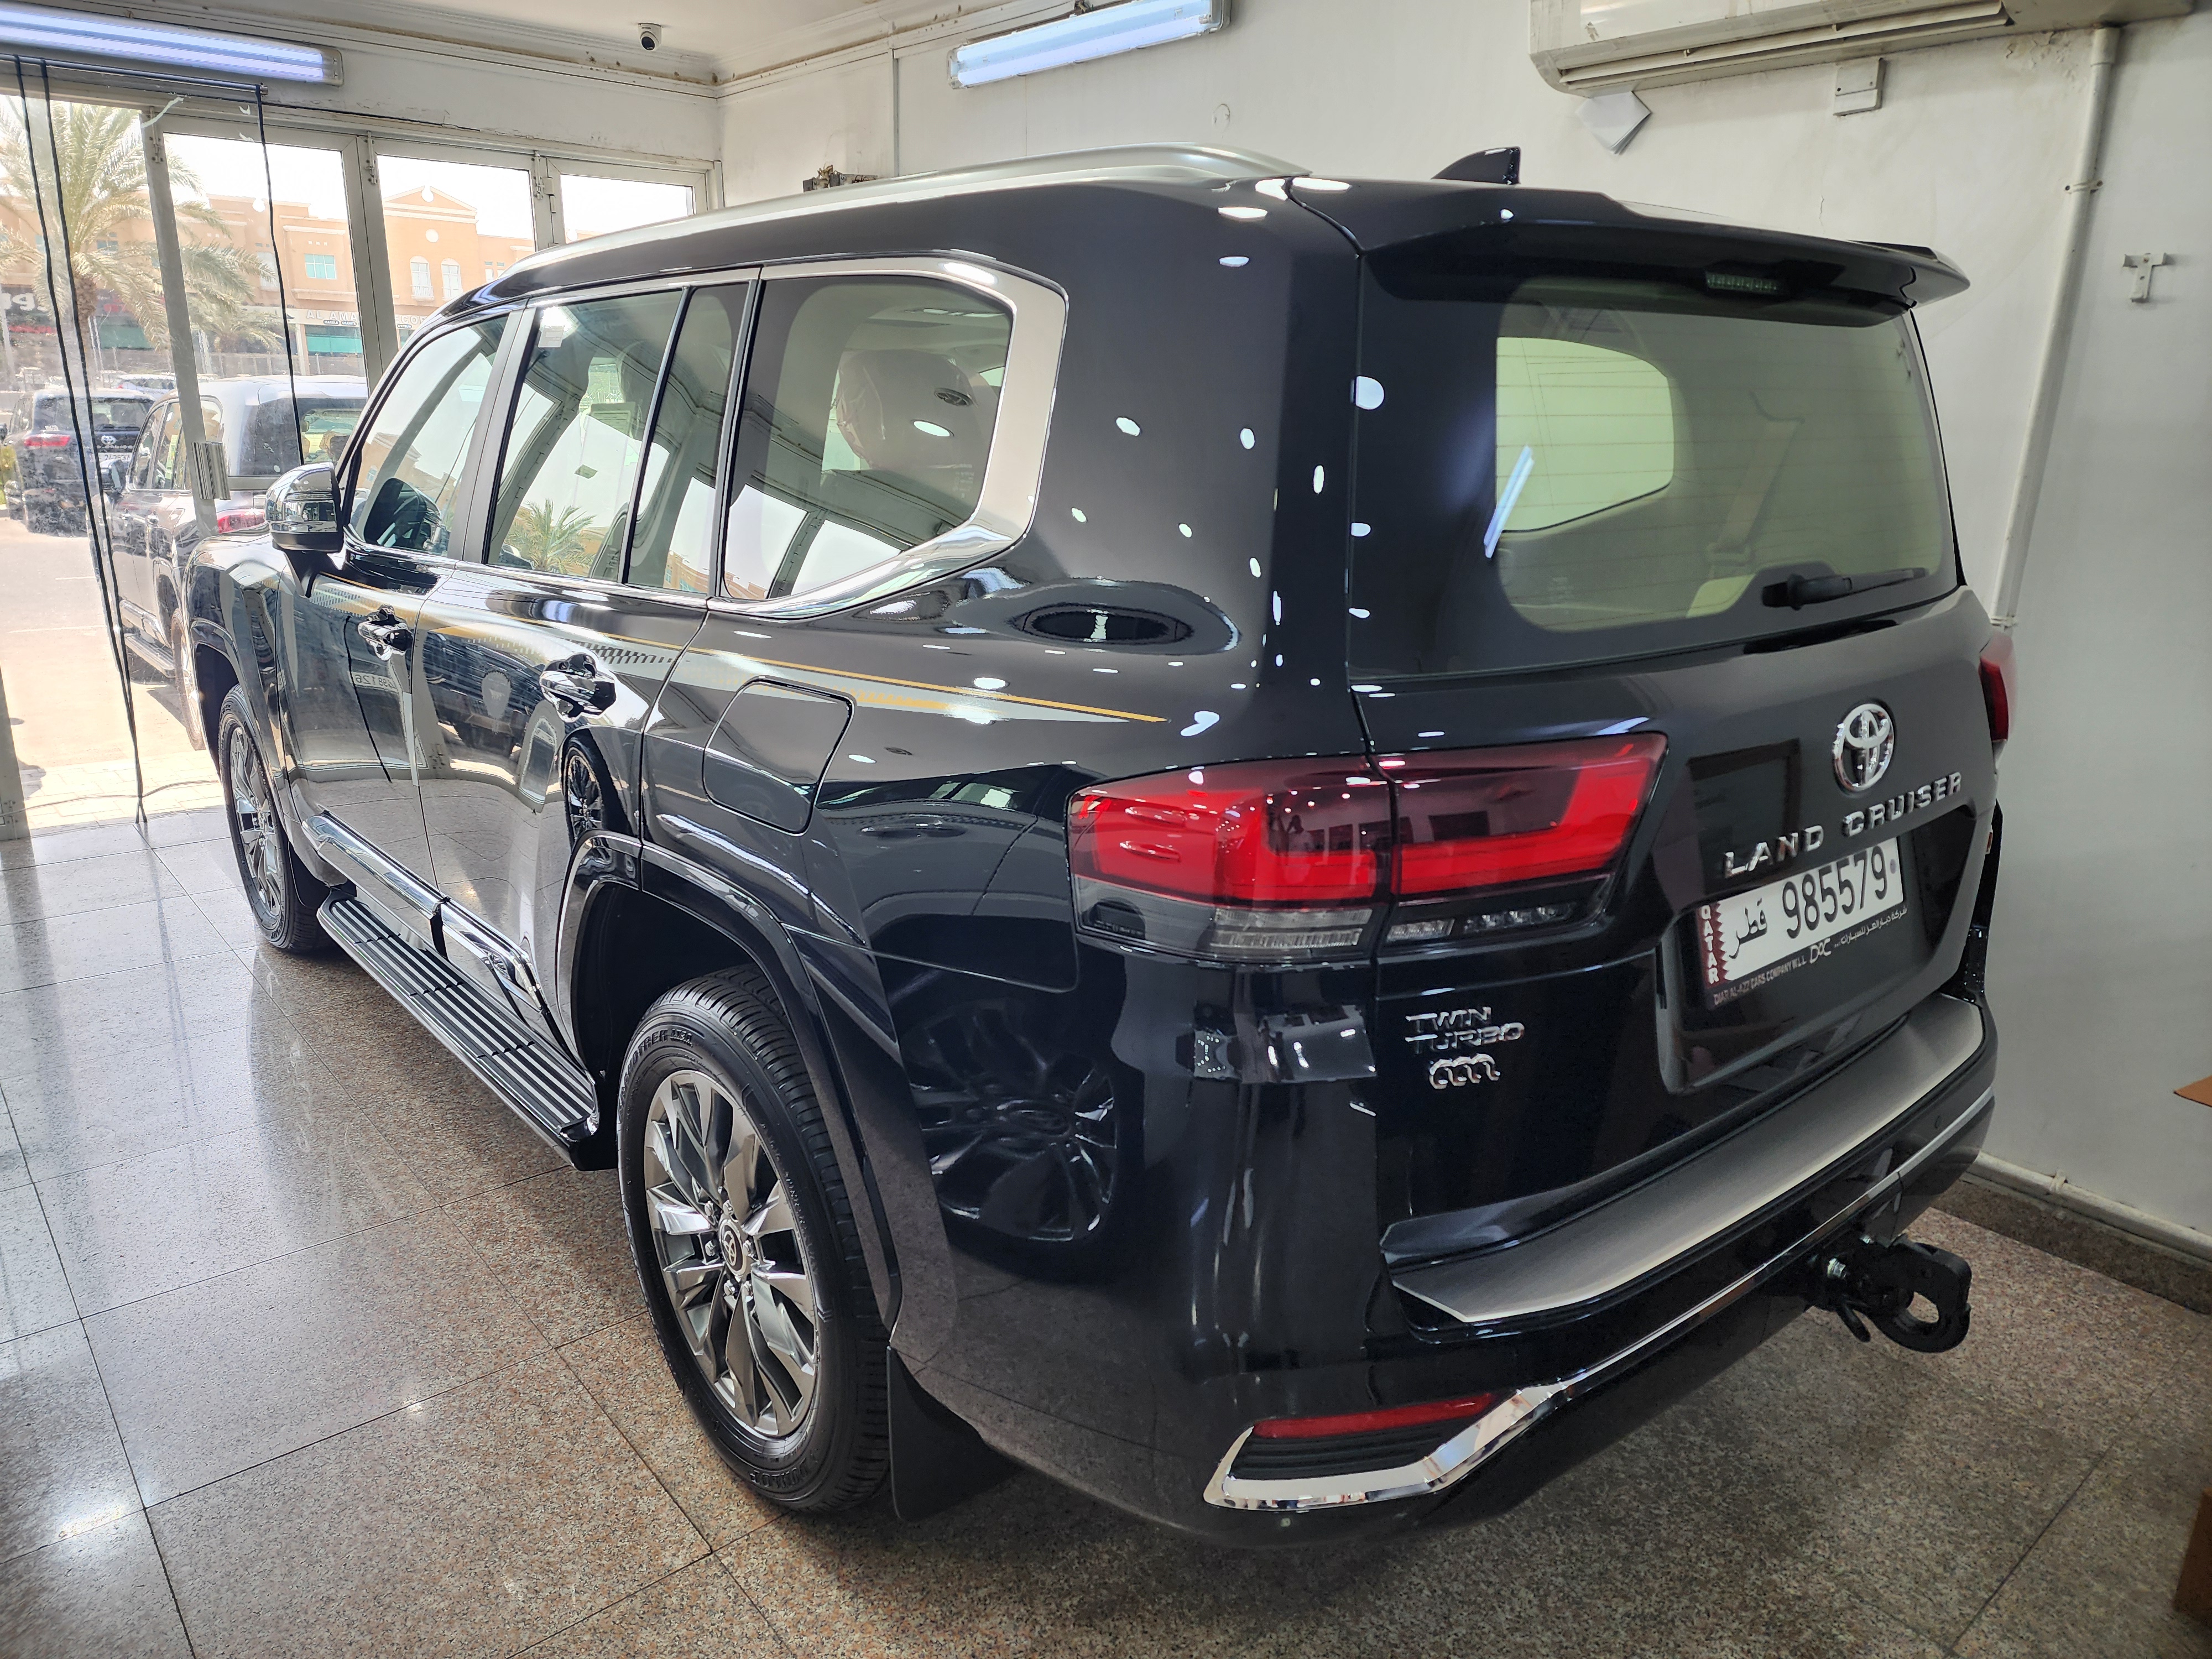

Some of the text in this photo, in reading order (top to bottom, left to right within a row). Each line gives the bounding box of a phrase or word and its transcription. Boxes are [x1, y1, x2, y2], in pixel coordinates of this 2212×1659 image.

[306, 310, 323, 319] AL
[1724, 771, 1961, 878] LAND CRUISER
[1782, 846, 1888, 939] 985579
[1701, 904, 1719, 984] QATAR
[1729, 898, 1768, 959] قطر
[1405, 1006, 1491, 1034] TWIN
[1405, 1022, 1525, 1055] TURBO
